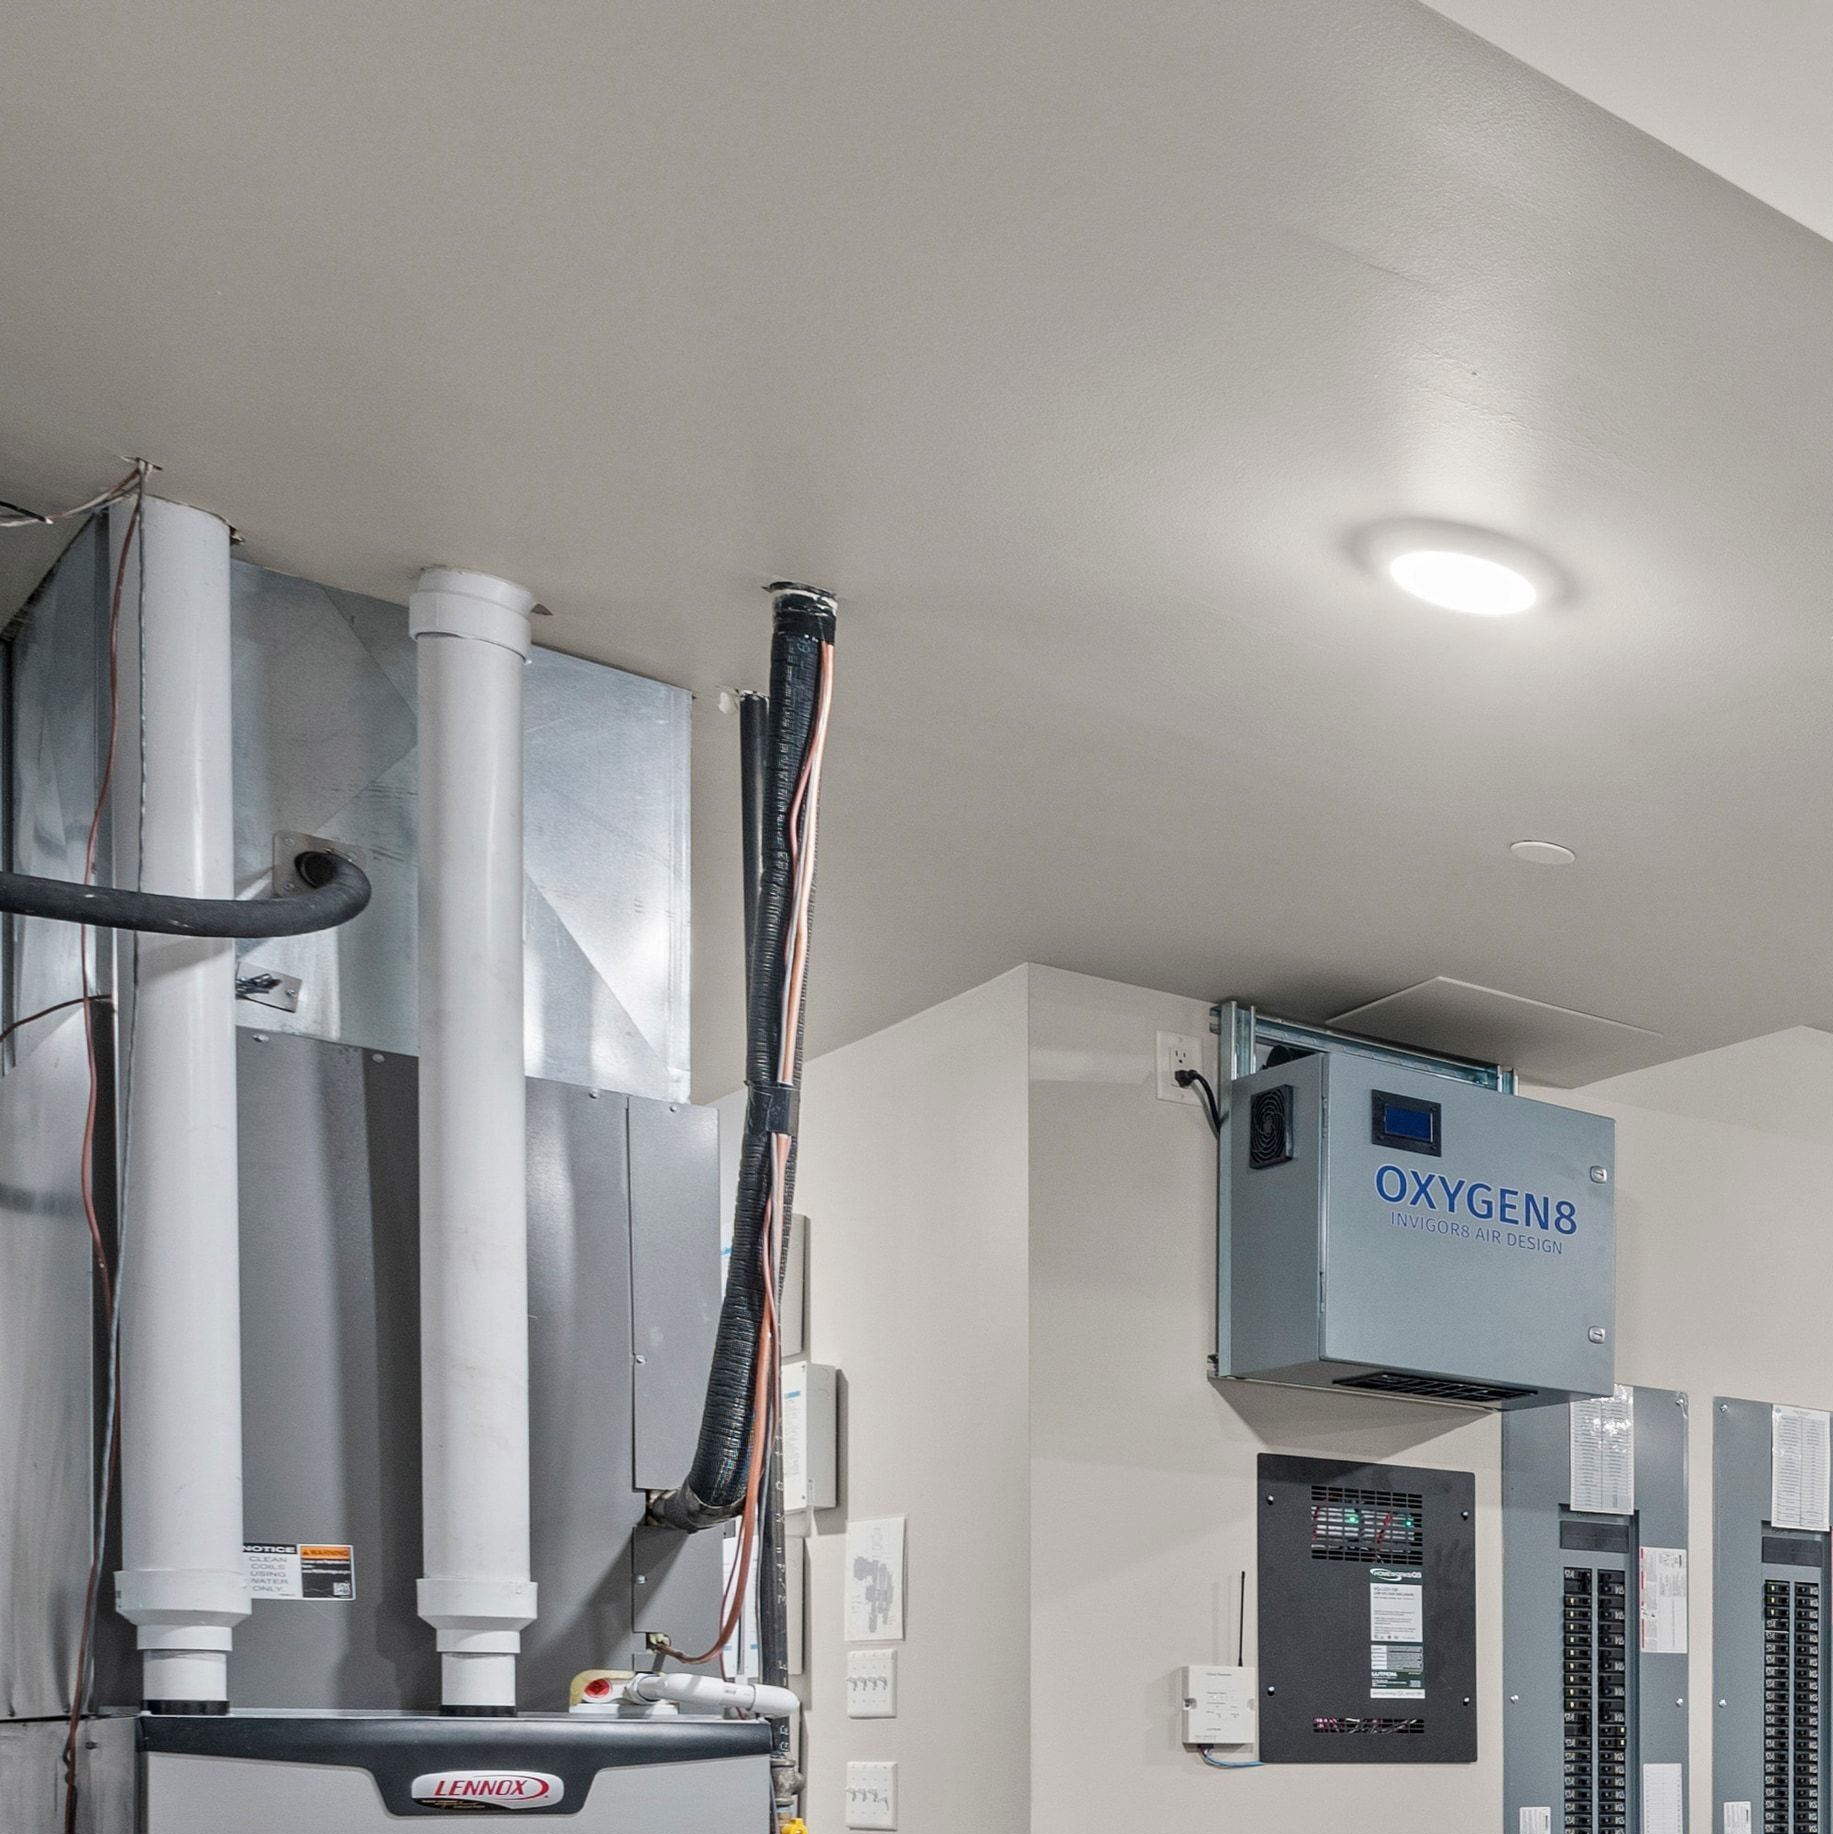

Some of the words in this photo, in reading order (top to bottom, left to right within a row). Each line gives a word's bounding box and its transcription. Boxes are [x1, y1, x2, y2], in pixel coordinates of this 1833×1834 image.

[1375, 1164, 1578, 1236] OXYGEN8
[1390, 1211, 1470, 1239] INVIGOR8
[1475, 1227, 1501, 1245] AIR
[1506, 1232, 1563, 1255] DESIGN
[242, 1545, 296, 1553] NOTICE
[434, 1779, 527, 1796] LENNOX
